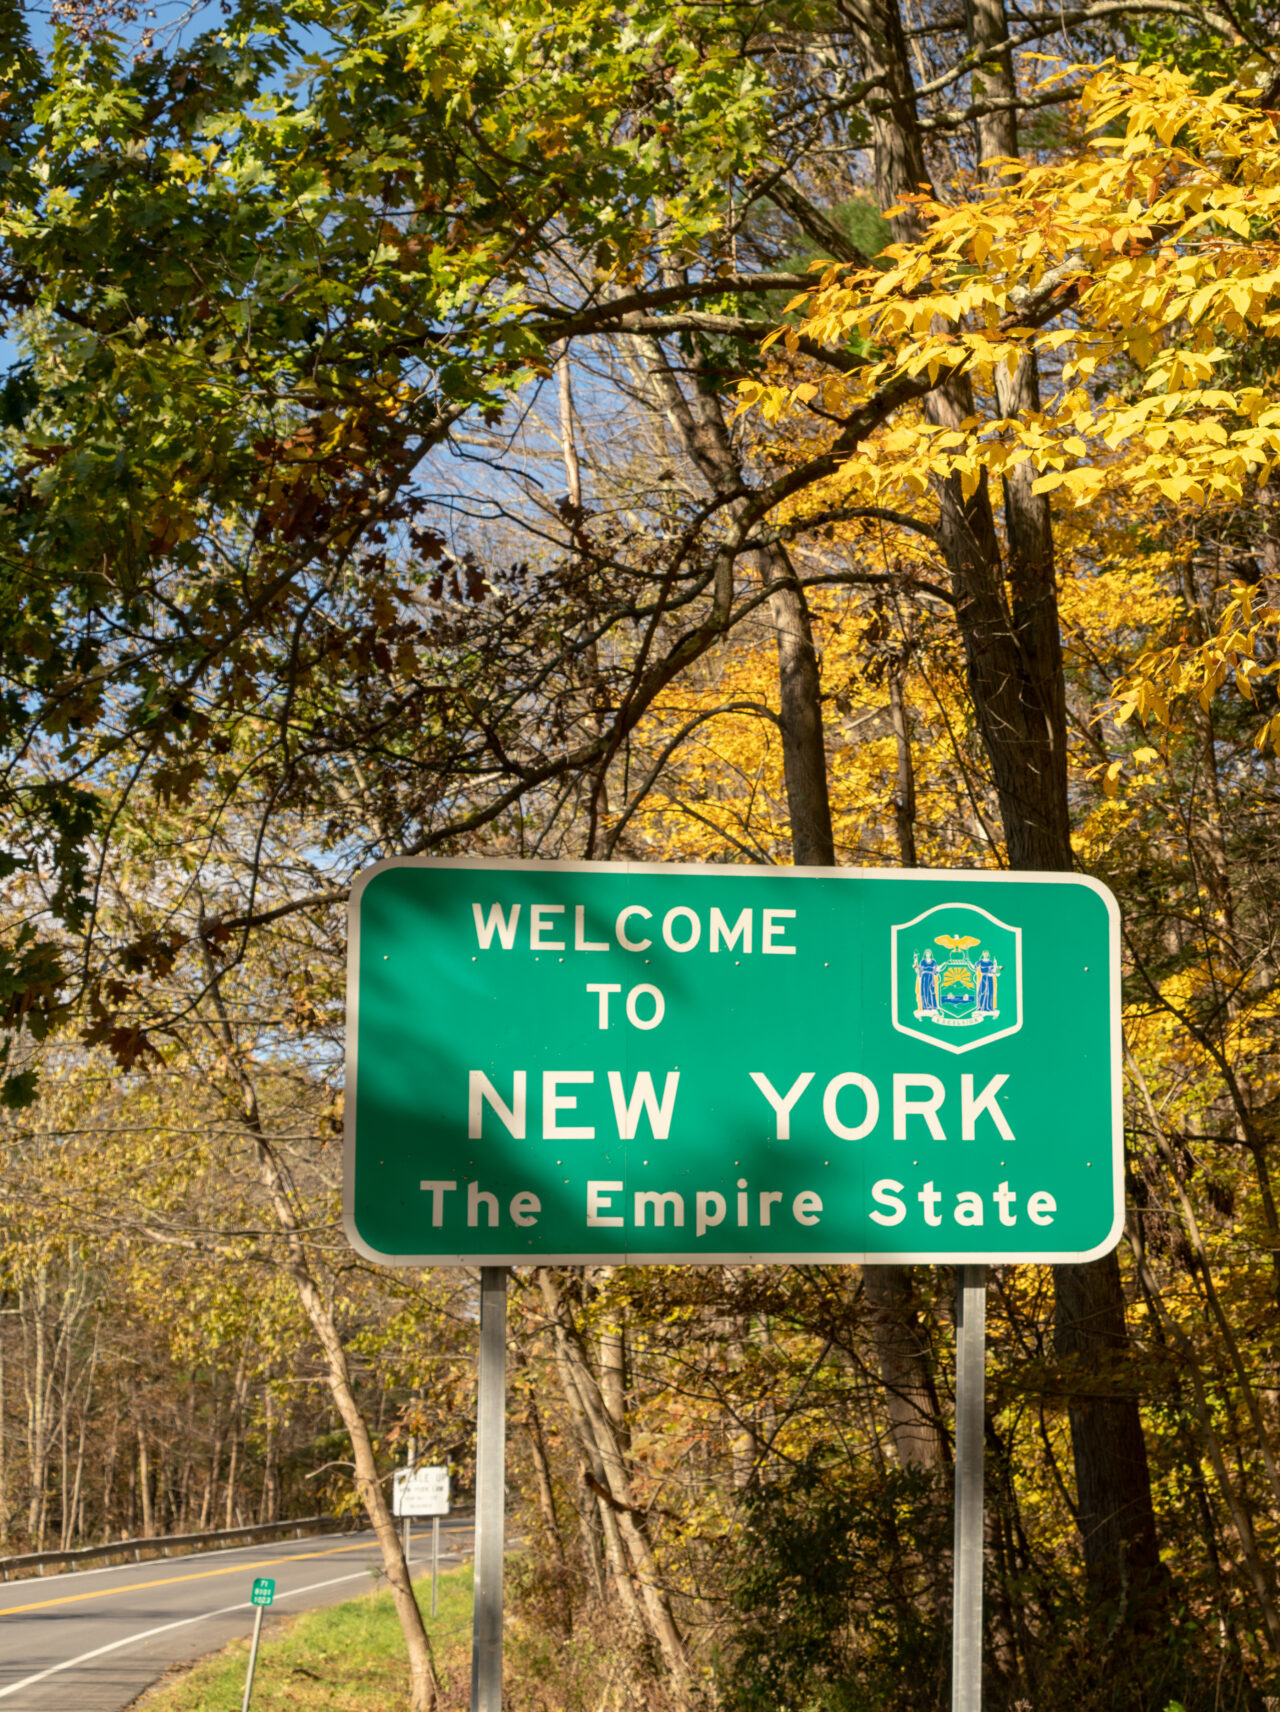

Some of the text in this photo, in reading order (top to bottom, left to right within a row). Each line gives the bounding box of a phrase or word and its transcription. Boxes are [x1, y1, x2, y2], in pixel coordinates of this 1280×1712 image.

[472, 902, 797, 955] WELCOME
[586, 983, 666, 1031] TO
[468, 1069, 1017, 1142] NEW YORK
[420, 1178, 1058, 1237] The Empire State
